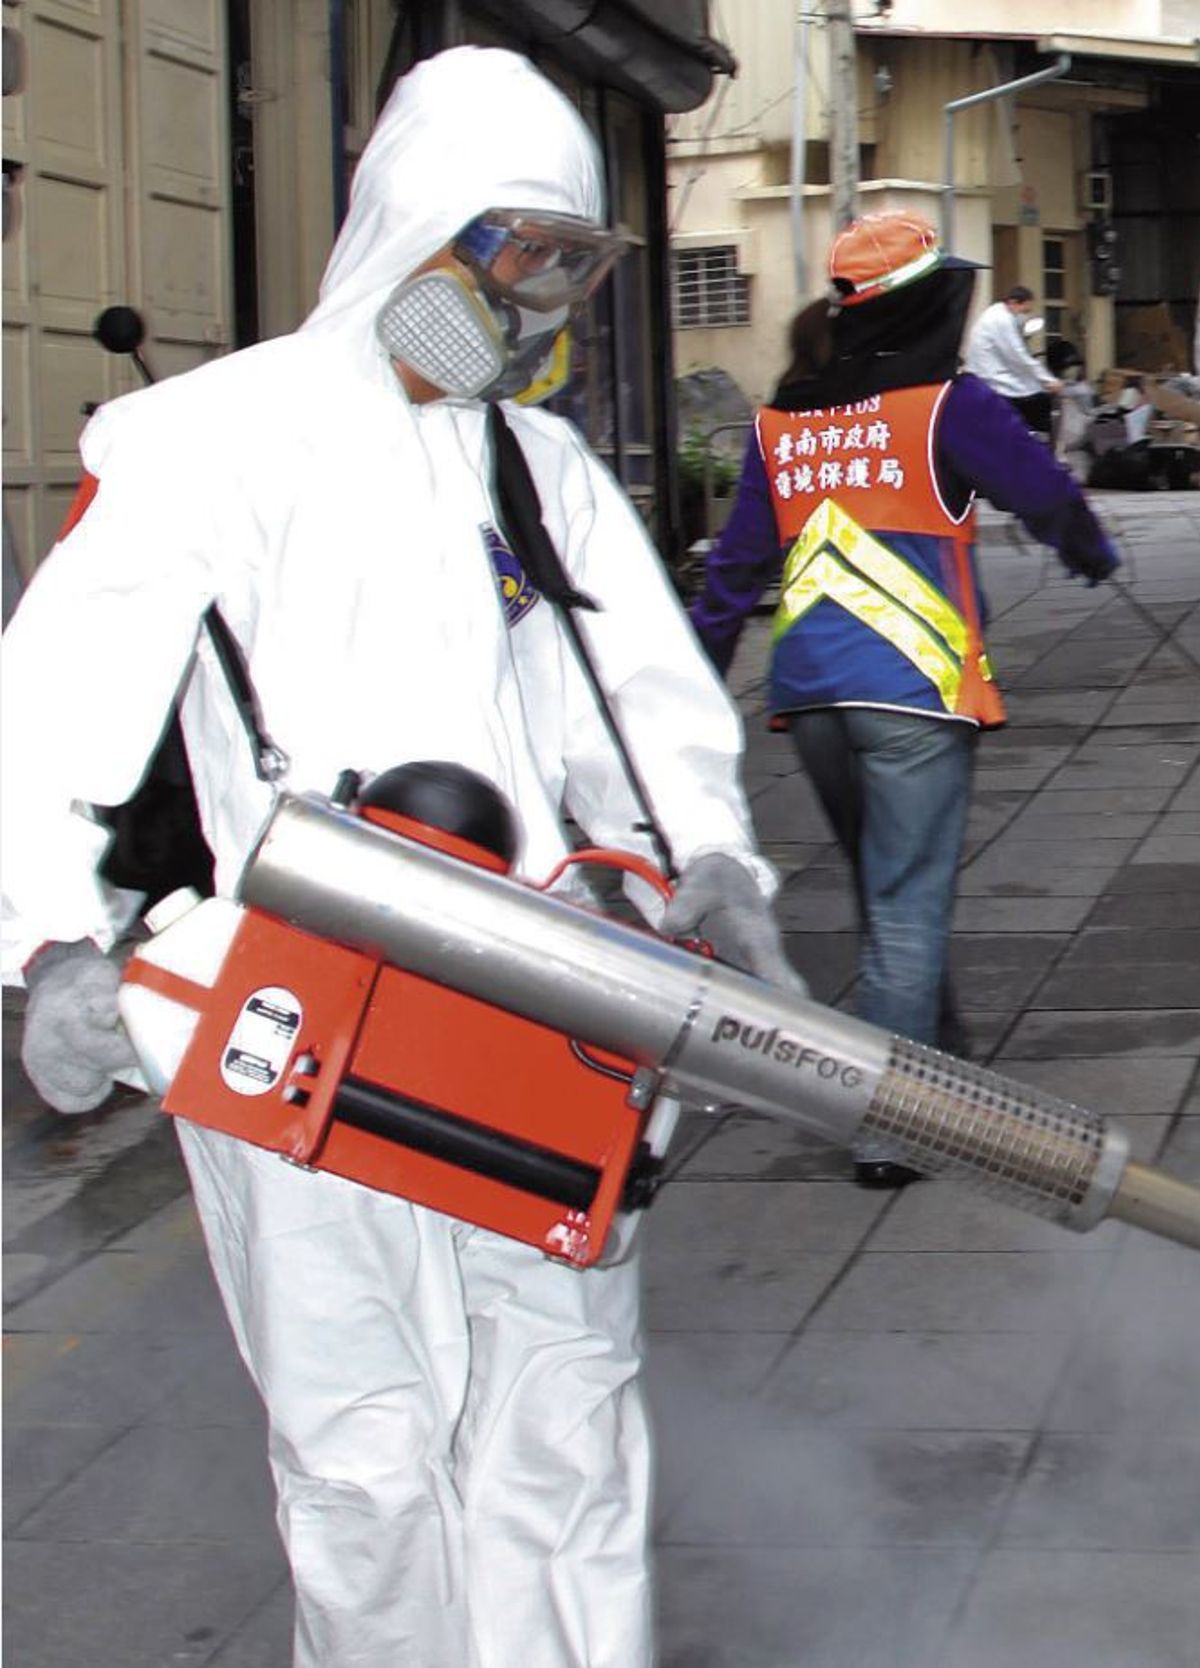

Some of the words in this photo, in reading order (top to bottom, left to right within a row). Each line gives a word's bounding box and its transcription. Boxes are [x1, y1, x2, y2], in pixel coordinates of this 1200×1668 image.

[774, 420, 891, 465] 臺南市政府
[711, 1015, 863, 1088] pulsFOG
